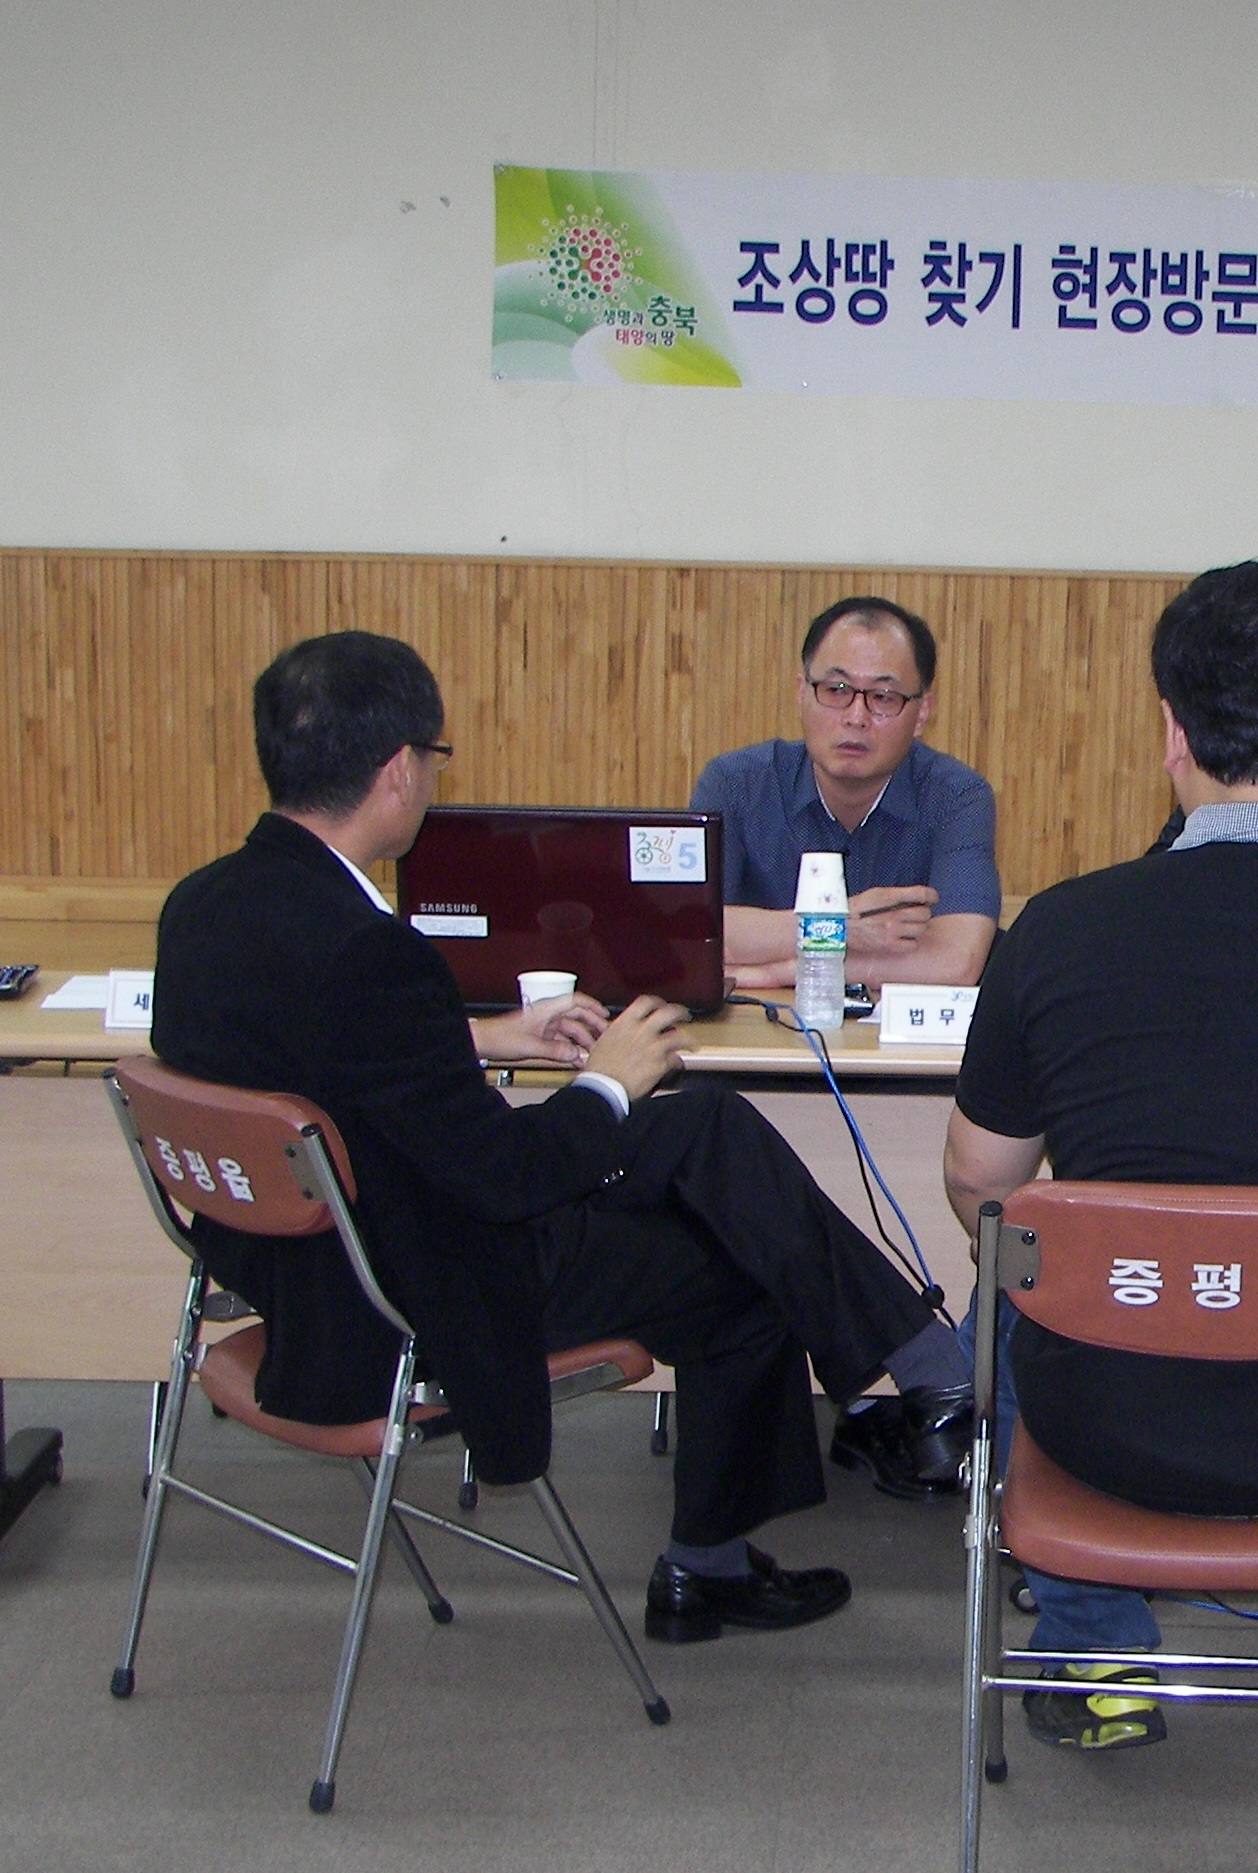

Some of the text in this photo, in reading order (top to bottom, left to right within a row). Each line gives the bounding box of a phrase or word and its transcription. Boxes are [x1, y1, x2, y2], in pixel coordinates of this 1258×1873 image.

[732, 237, 895, 326] 조상땅
[920, 239, 1023, 330] 찾기
[603, 295, 698, 336] 생명과 충북
[616, 328, 675, 347] 태양의 땅
[420, 902, 478, 914] SAMSUNG
[133, 992, 150, 1011] 세
